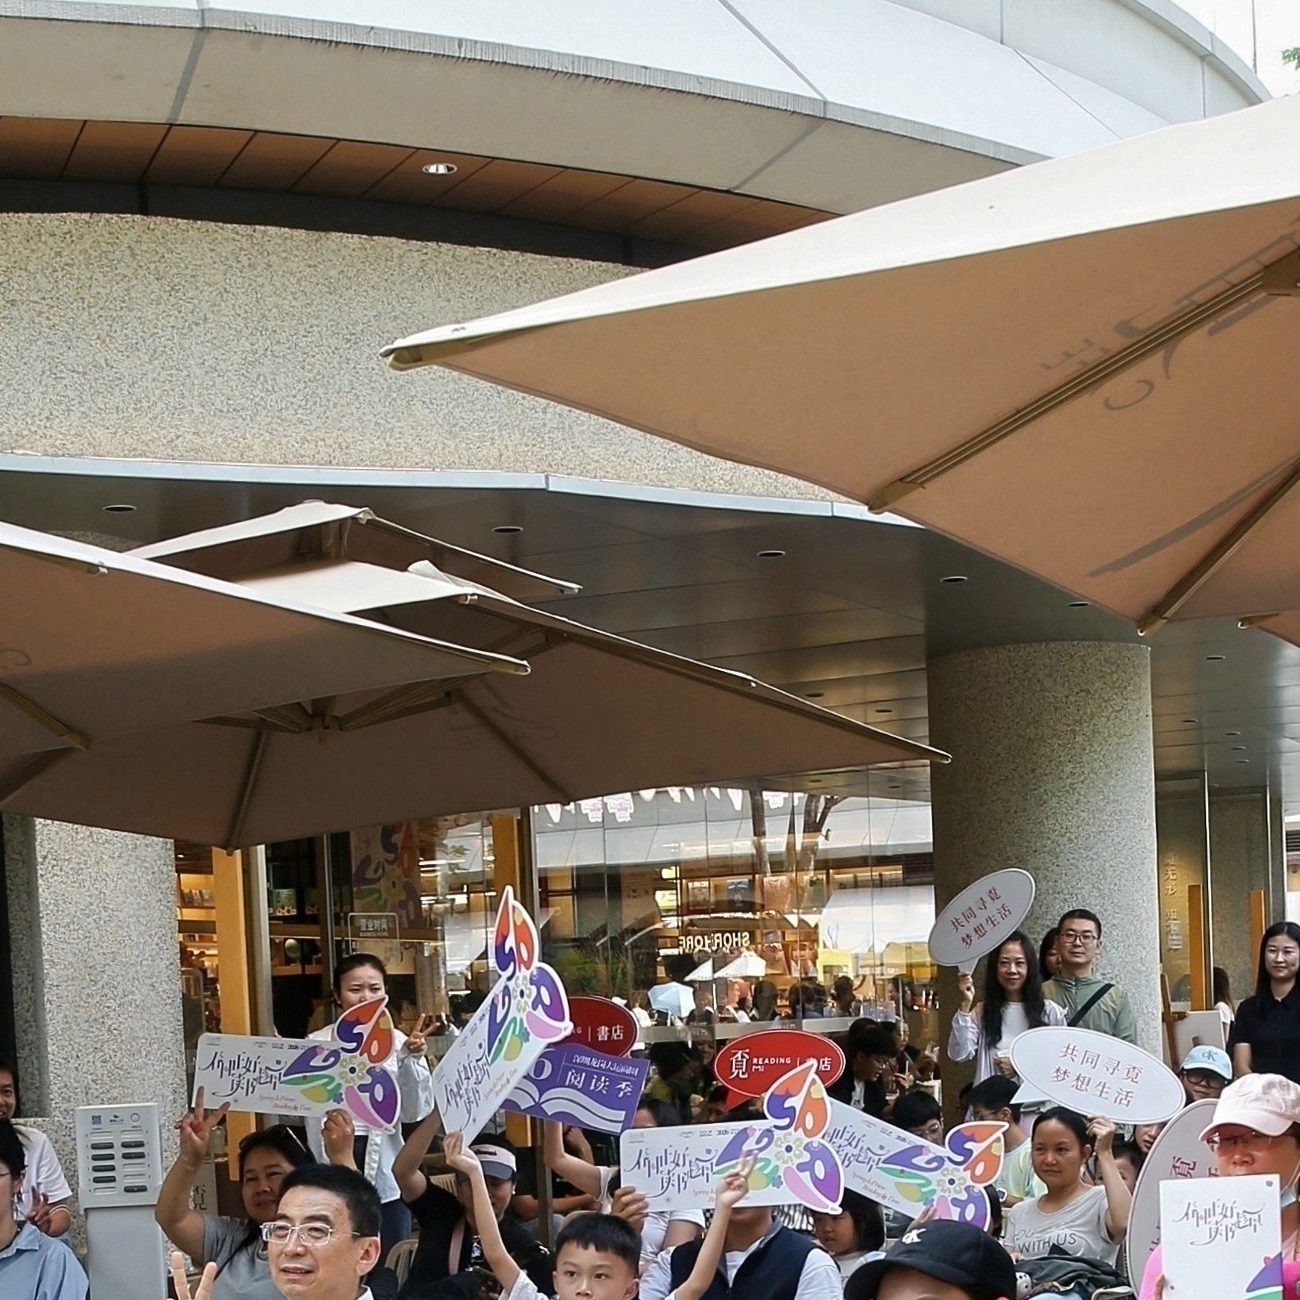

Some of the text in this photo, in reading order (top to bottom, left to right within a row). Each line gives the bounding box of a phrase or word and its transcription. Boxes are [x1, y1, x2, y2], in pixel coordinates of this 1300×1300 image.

[961, 903, 1012, 949] 梦想生活
[596, 1025, 624, 1041] 書店
[752, 1056, 792, 1065] READING
[565, 1069, 634, 1098] 阅读季
[1050, 1065, 1135, 1108] 梦想生活
[1018, 1232, 1077, 1254] WITH US
